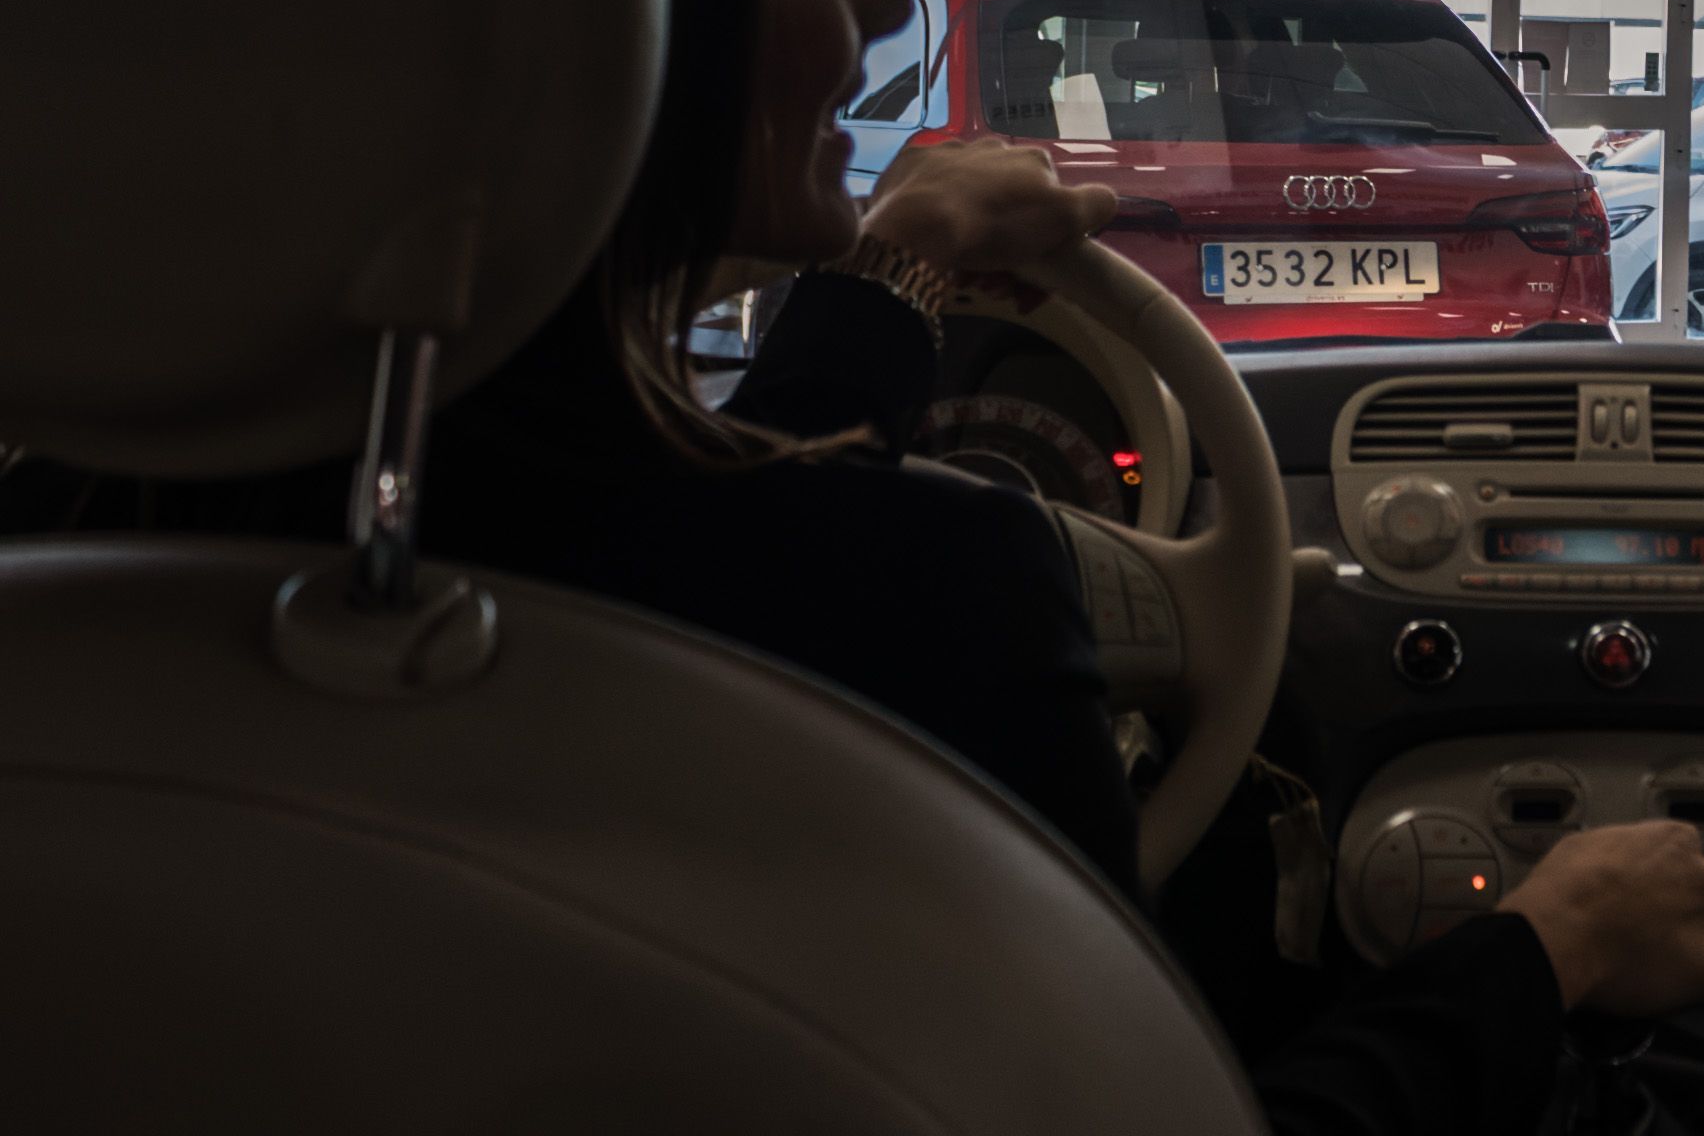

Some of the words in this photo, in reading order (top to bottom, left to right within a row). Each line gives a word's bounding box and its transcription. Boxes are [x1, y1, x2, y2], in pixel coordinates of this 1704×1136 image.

[1230, 249, 1335, 287] 3532
[1351, 248, 1426, 285] KPL
[1210, 275, 1219, 285] E
[1527, 282, 1554, 293] TDI
